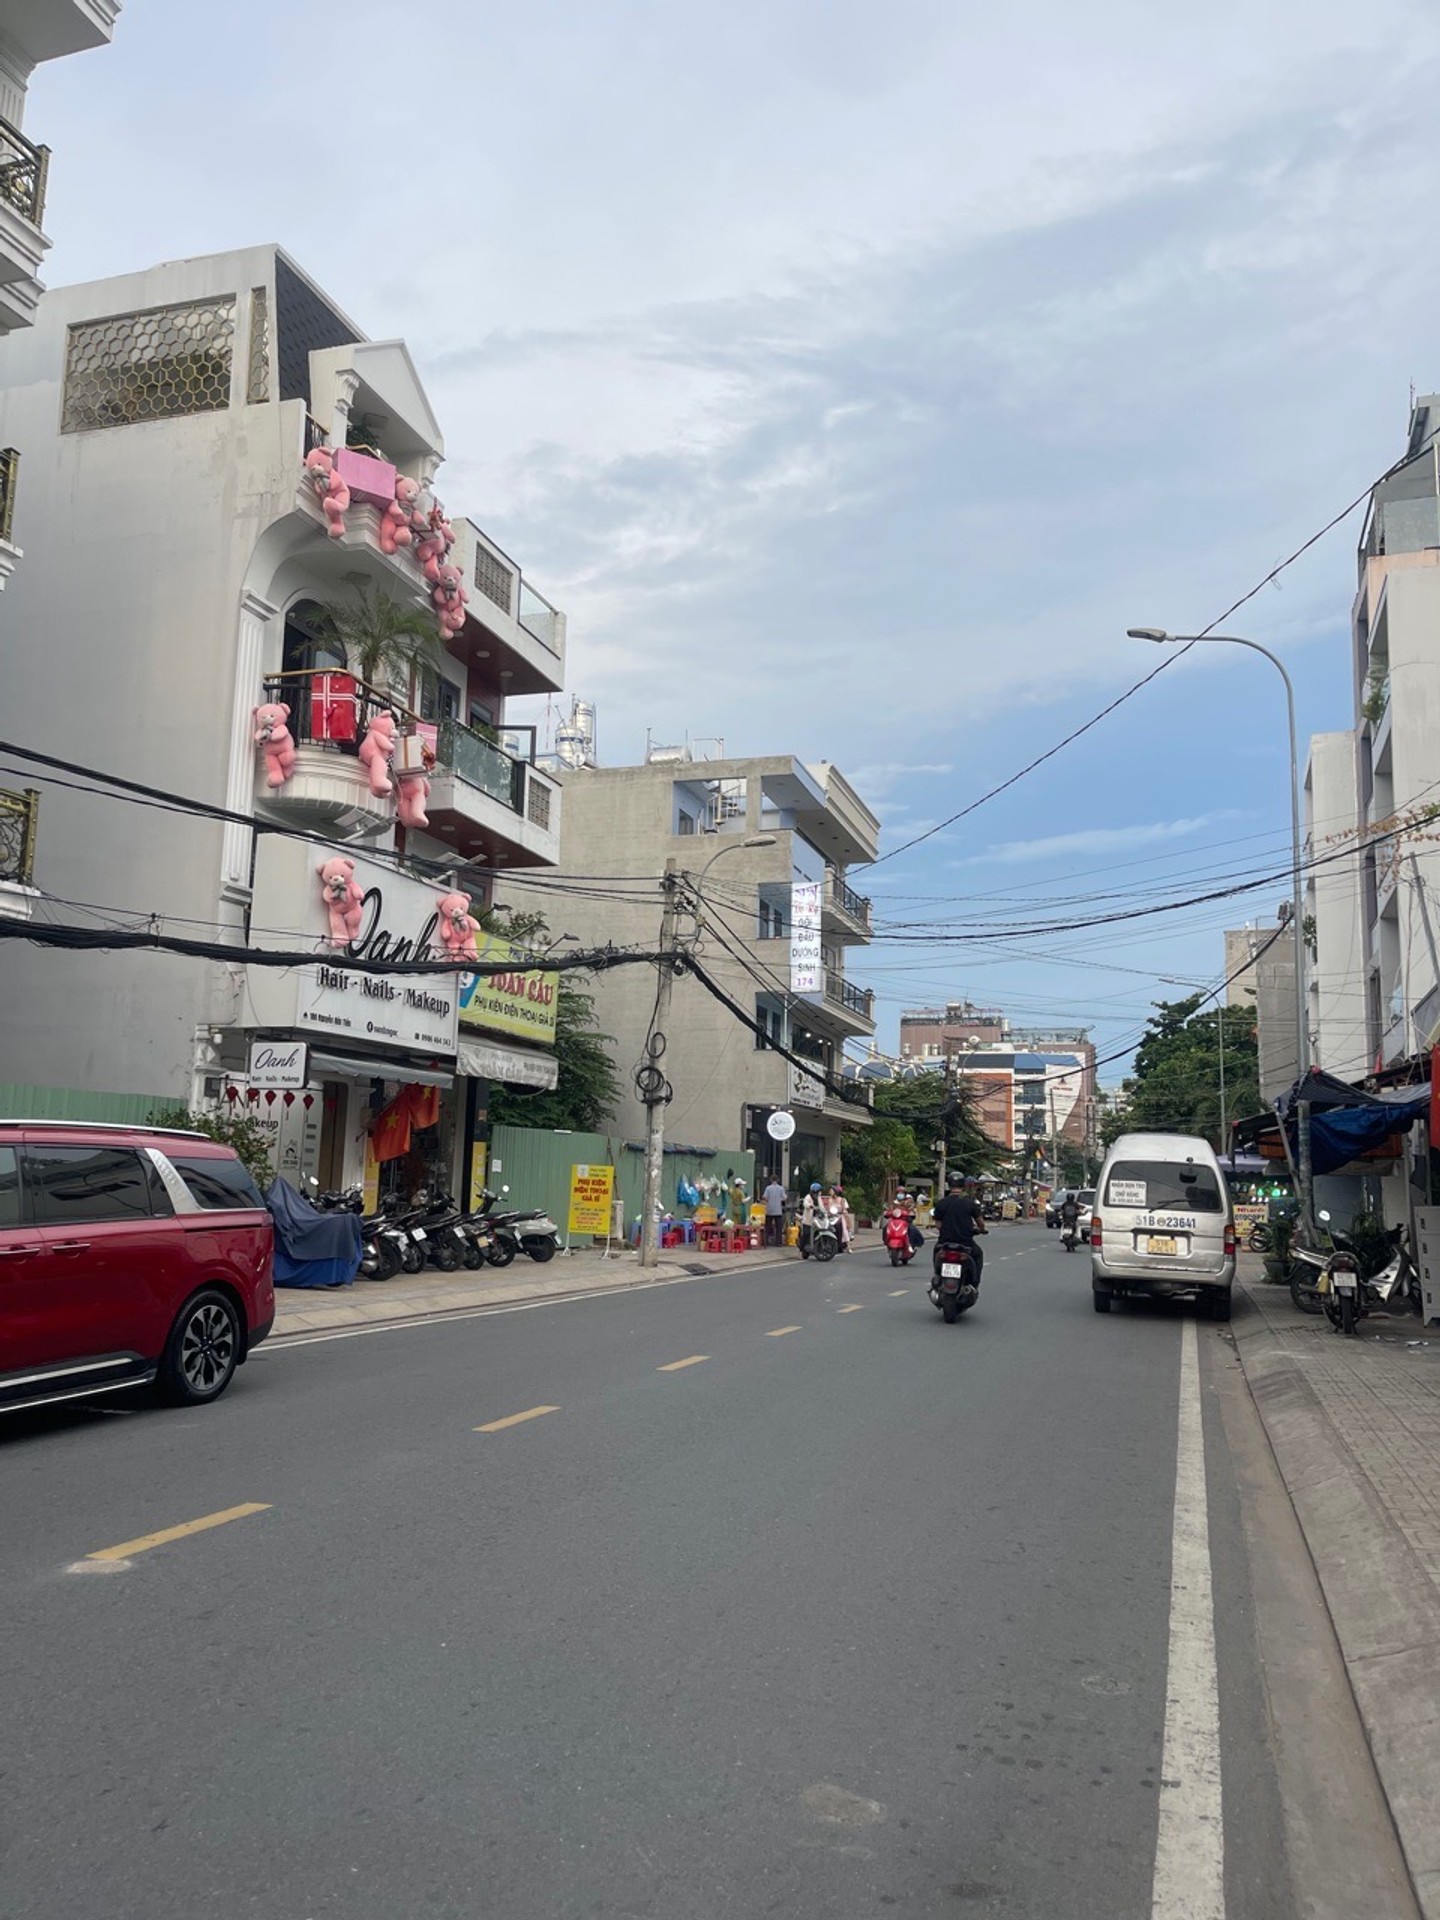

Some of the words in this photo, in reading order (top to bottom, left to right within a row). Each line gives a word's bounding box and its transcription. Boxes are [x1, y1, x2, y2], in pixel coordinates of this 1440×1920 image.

[318, 966, 349, 990] Hair
[361, 976, 395, 1000] Nails
[404, 988, 450, 1018] Makeup
[254, 1048, 300, 1070] Oanh
[1136, 1214, 1155, 1227] 51B
